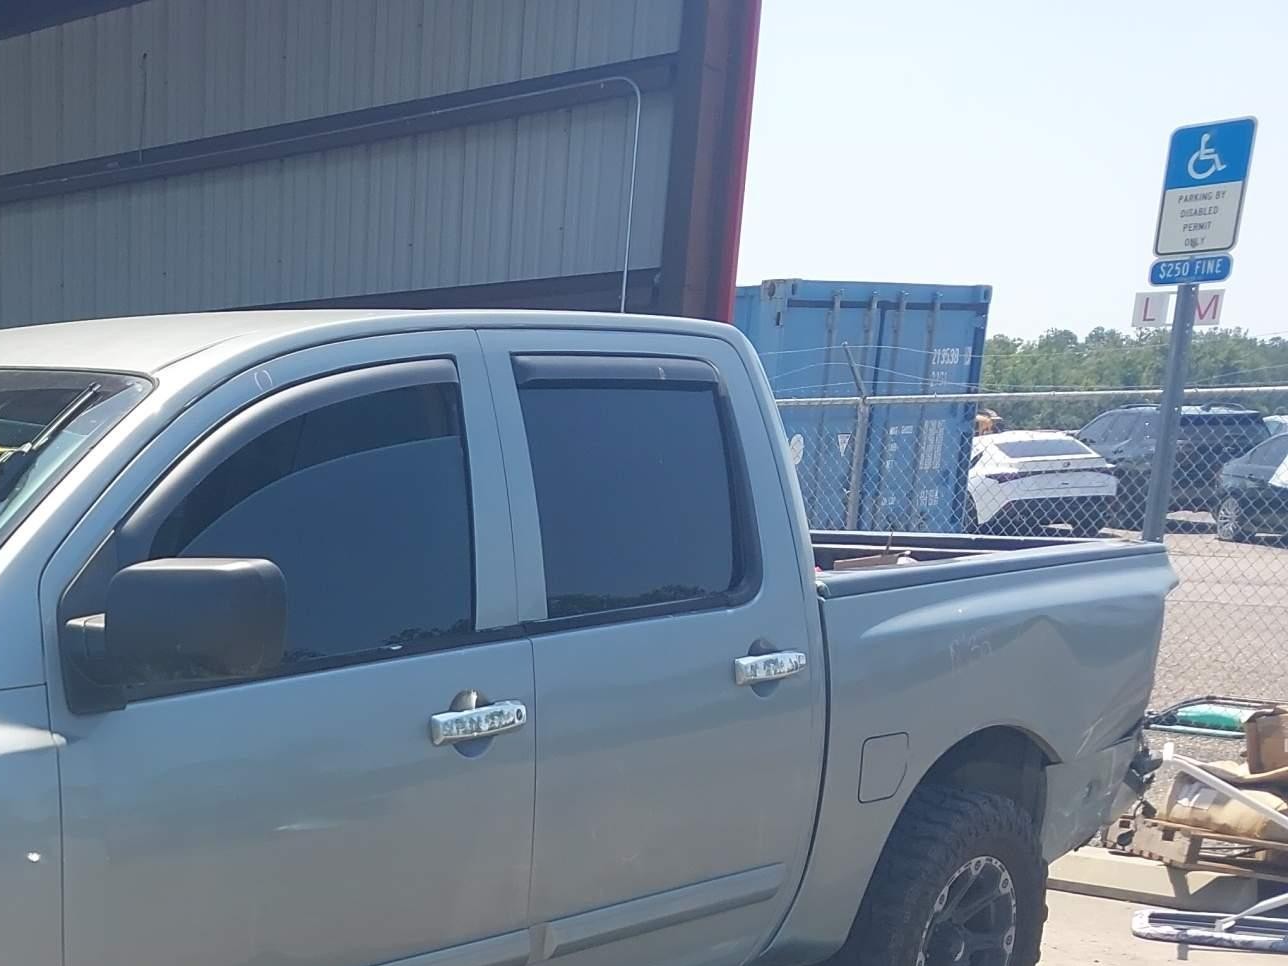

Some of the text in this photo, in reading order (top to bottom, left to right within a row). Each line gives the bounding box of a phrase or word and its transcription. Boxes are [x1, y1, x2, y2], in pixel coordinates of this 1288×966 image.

[1178, 190, 1226, 203] PARKING BY
[1180, 206, 1219, 217] DISABLED
[1183, 221, 1211, 232] PERMIT
[1160, 258, 1223, 279] $250 FINE
[1142, 297, 1156, 321] L
[1195, 294, 1220, 321] M
